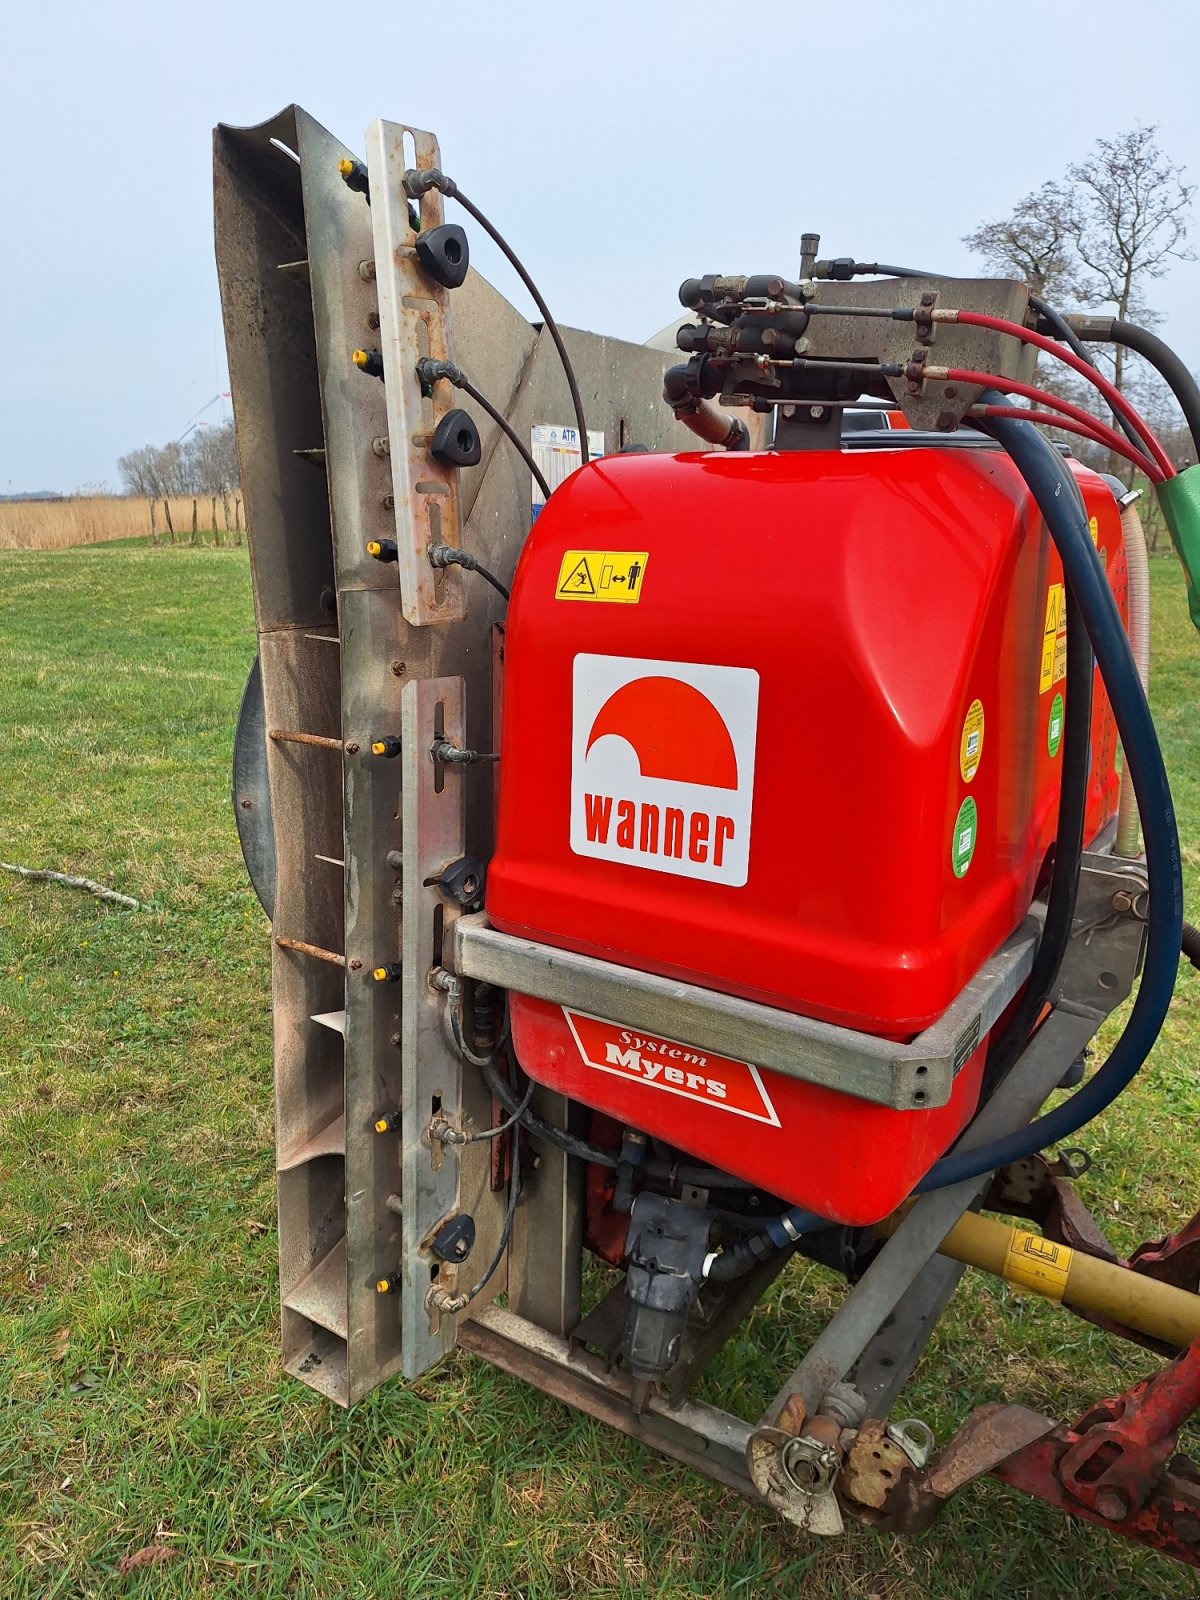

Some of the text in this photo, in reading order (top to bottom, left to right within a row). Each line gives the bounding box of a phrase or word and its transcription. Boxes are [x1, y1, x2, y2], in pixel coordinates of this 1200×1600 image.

[562, 428, 576, 442] ATR
[584, 793, 735, 867] wanner
[605, 1042, 727, 1099] Myers
[618, 1031, 708, 1067] System
